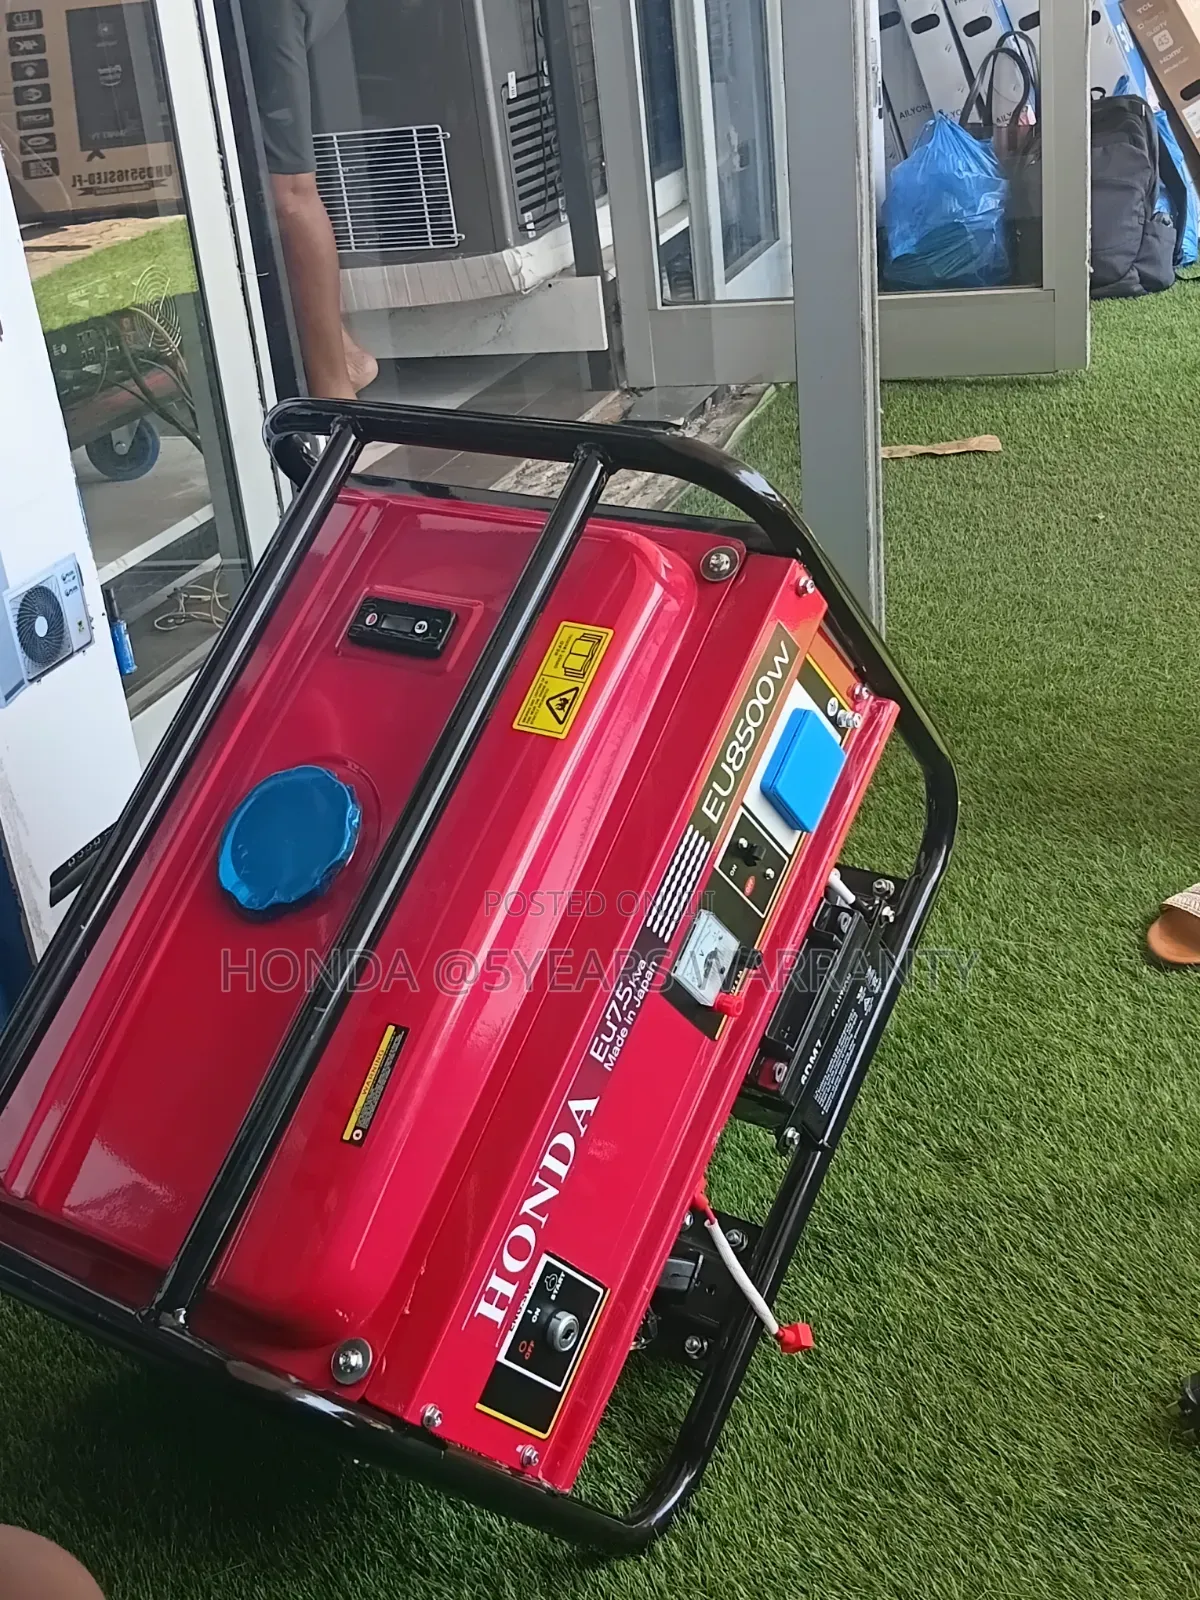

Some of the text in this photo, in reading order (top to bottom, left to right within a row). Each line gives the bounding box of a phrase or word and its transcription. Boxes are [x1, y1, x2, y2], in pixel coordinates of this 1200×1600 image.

[1136, 2, 1154, 14] TCL
[729, 864, 738, 877] ON
[603, 961, 658, 1071] Made in Japan
[362, 1049, 385, 1095] WARNING
[474, 1096, 600, 1330] HONDA
[550, 1271, 566, 1301] START
[531, 1307, 541, 1323] ON
[524, 1340, 535, 1360] OFF
